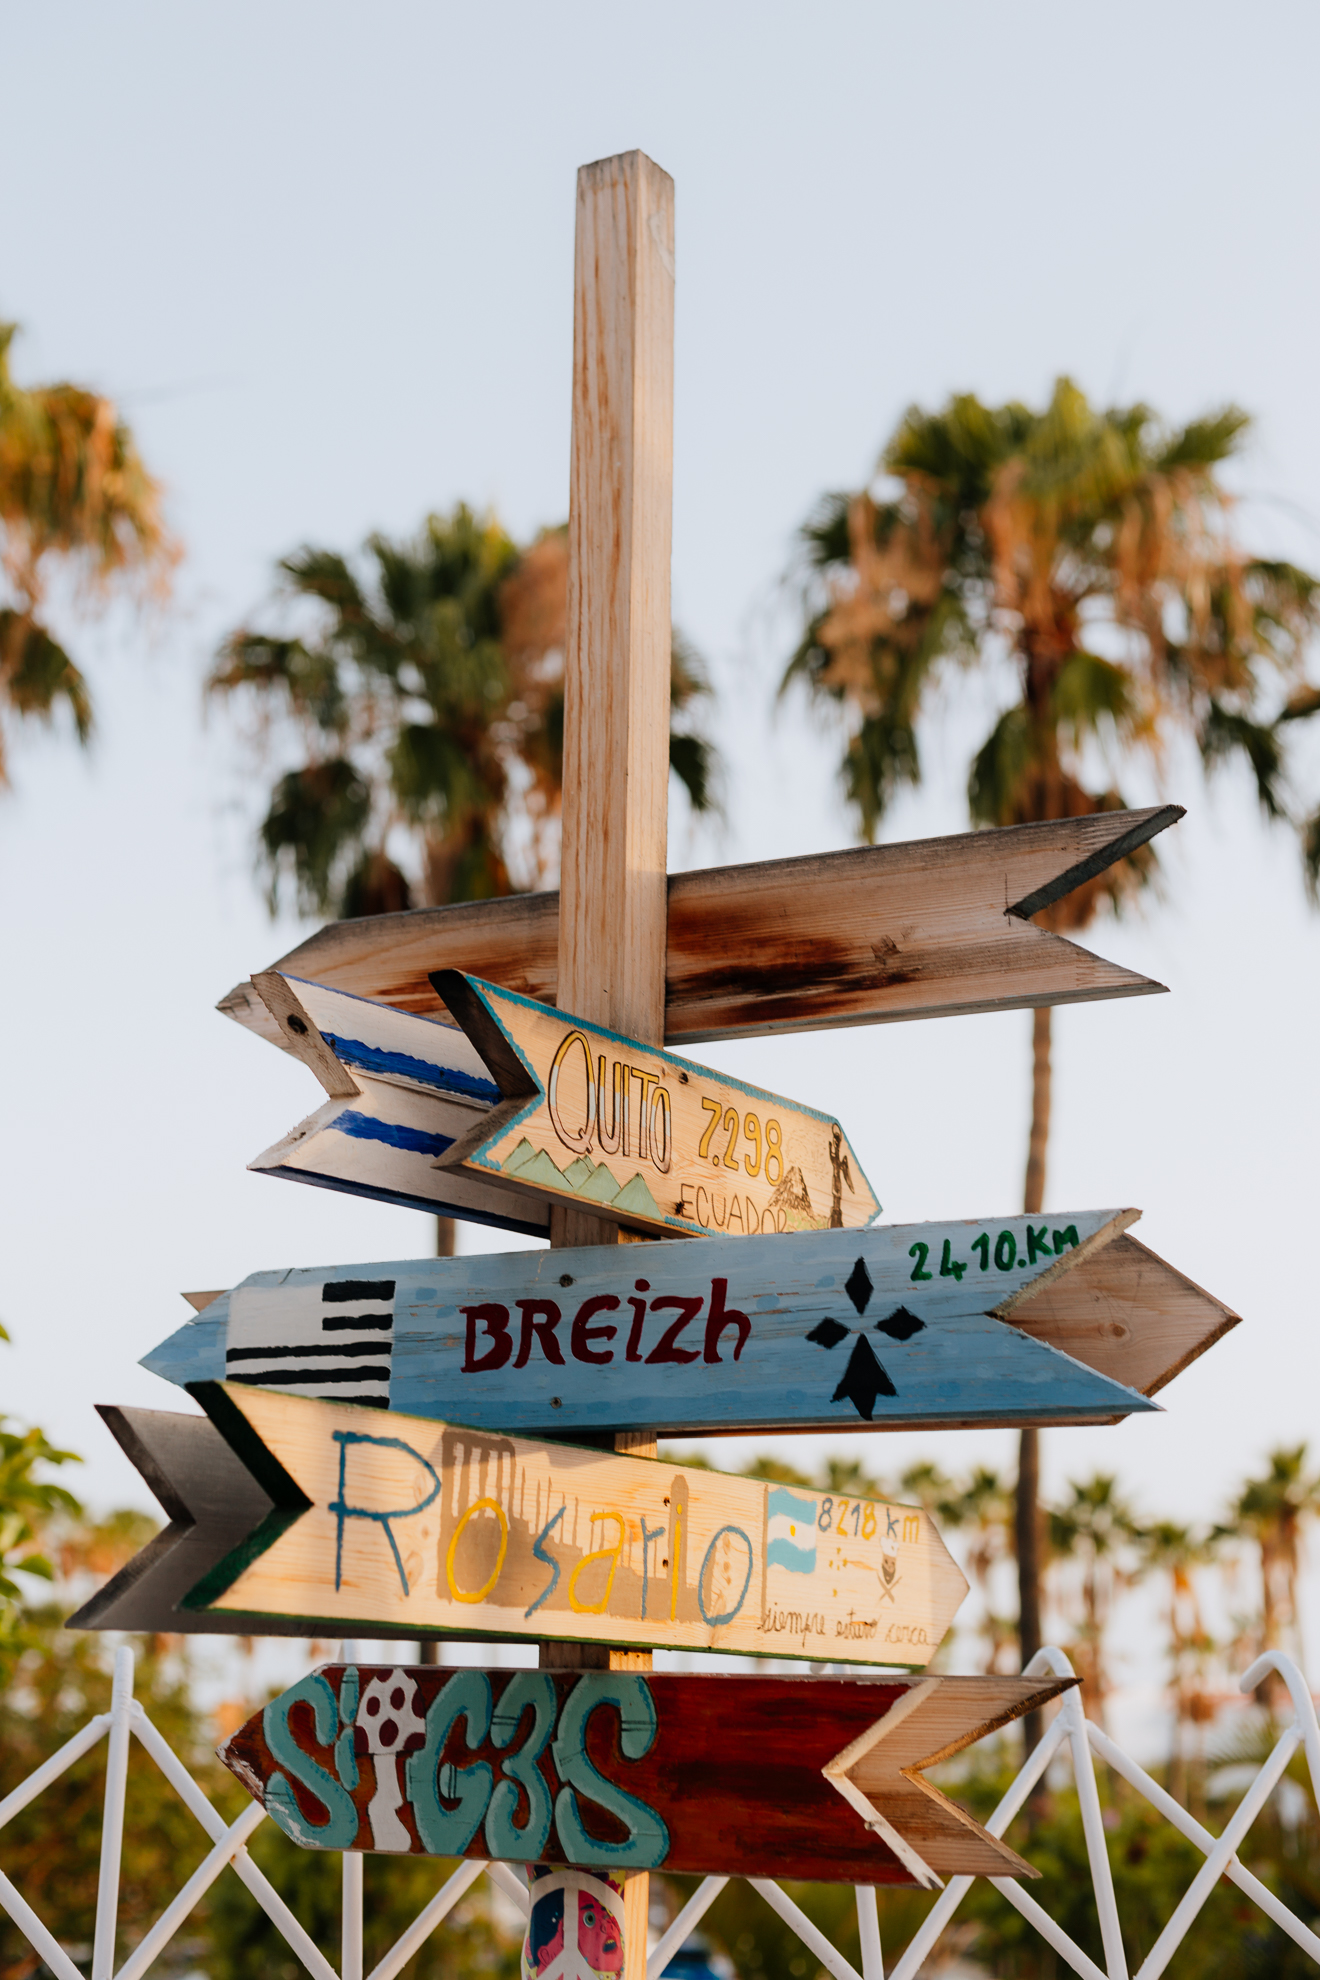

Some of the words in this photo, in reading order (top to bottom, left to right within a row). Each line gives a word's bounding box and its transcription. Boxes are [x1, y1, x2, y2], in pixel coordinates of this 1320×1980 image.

[548, 1030, 672, 1174] QUITO
[698, 1097, 785, 1186] 7.298
[327, 1430, 754, 1626] Rosario
[818, 1497, 877, 1540] 8218
[757, 1602, 826, 1648] siempre
[885, 1623, 934, 1647] cerca
